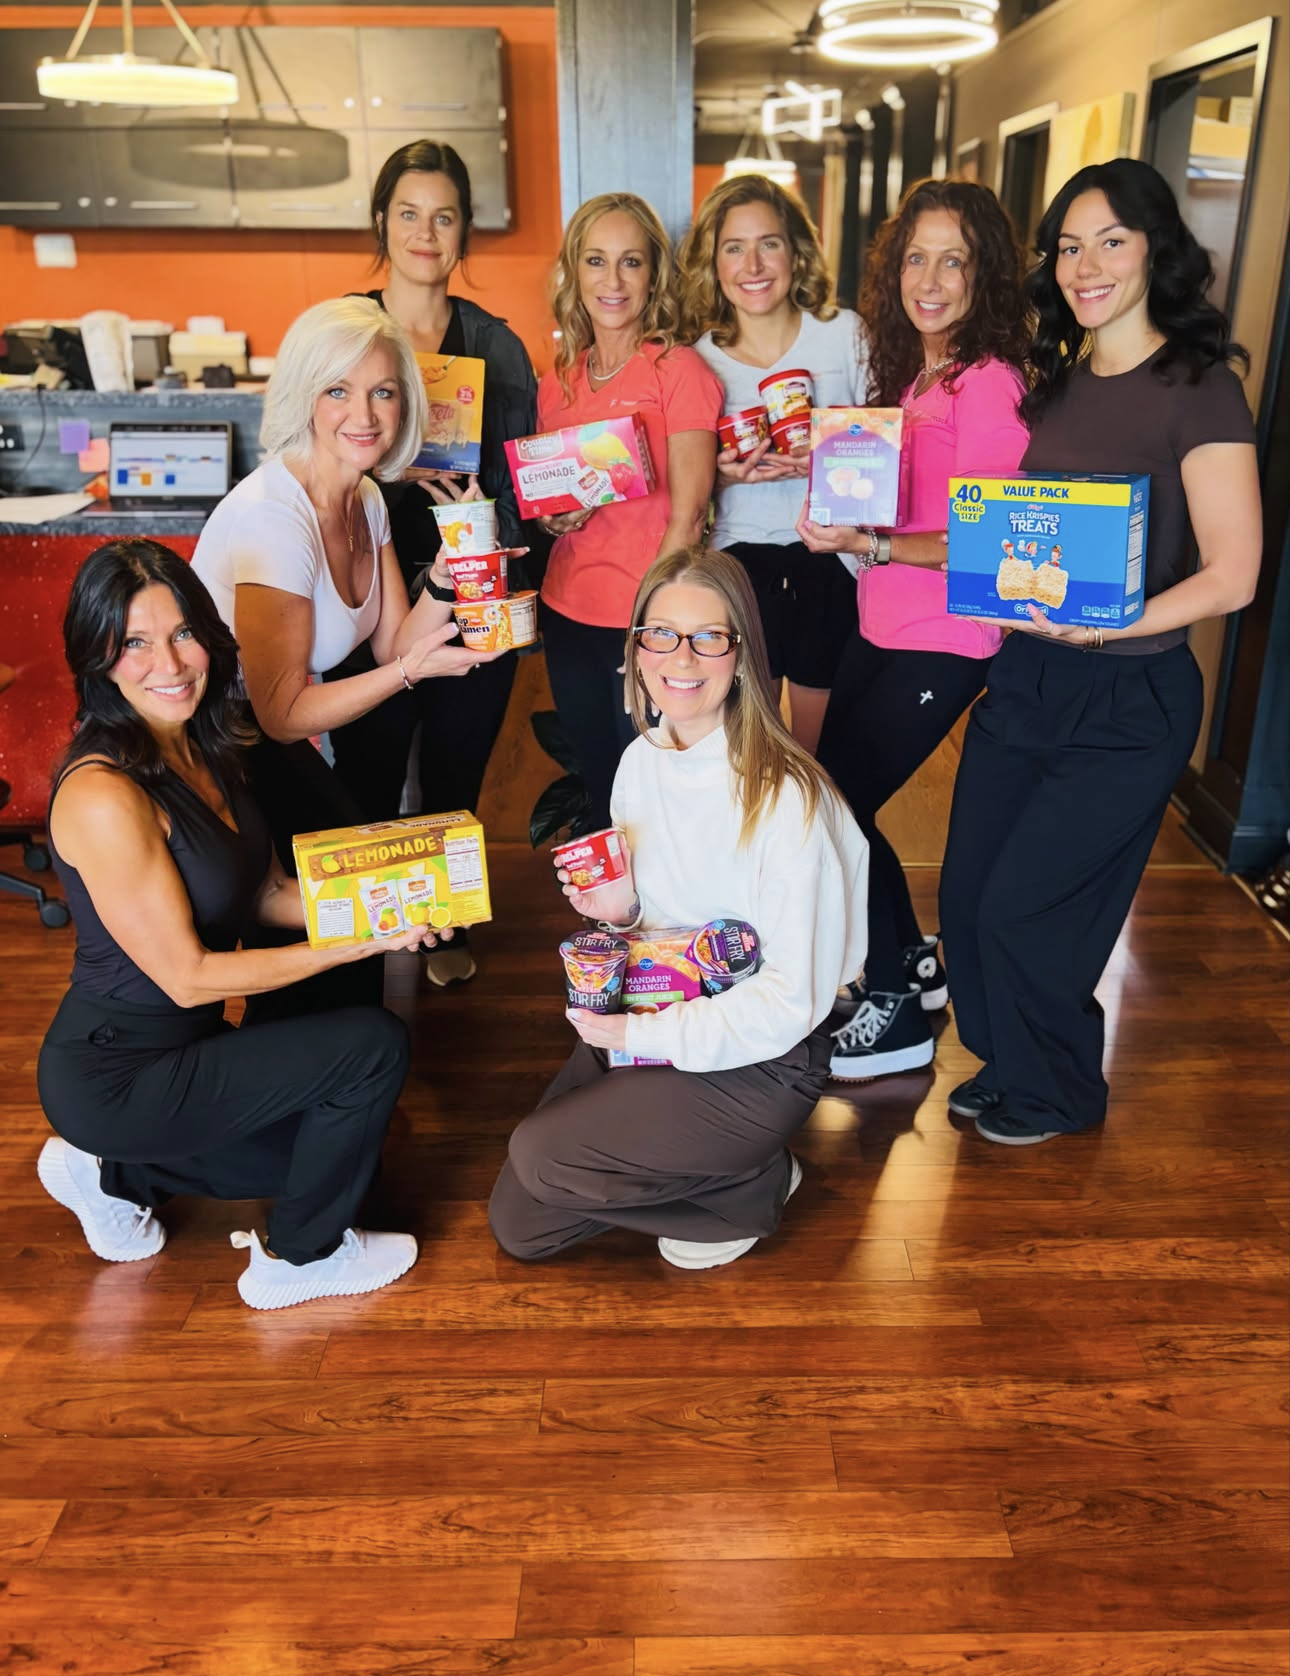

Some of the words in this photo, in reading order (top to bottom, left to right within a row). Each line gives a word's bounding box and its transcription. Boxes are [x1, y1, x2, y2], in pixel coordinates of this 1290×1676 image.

[833, 440, 877, 449] MANDARIN
[836, 448, 874, 457] ORANGES
[521, 465, 576, 484] LEMONADE
[583, 477, 609, 508] LEMONADE
[956, 484, 982, 503] 40
[1003, 485, 1036, 498] VALUE
[1039, 487, 1070, 499] PACK
[954, 503, 984, 513] Classic
[960, 513, 978, 521] SIZE
[1009, 511, 1026, 521] RICE
[1026, 510, 1060, 523] KRISPIES
[1010, 519, 1059, 536] TREATS
[343, 836, 438, 869] LEMONADE
[404, 888, 433, 904] LEMONADE
[574, 936, 597, 947] STIR
[599, 938, 618, 949] FRY
[723, 926, 742, 946] STIR
[727, 945, 746, 963] FRY
[625, 975, 672, 985] MANDARIN
[628, 983, 671, 993] ORANGES
[568, 988, 589, 1007] STIR
[590, 992, 610, 1007] FRY
